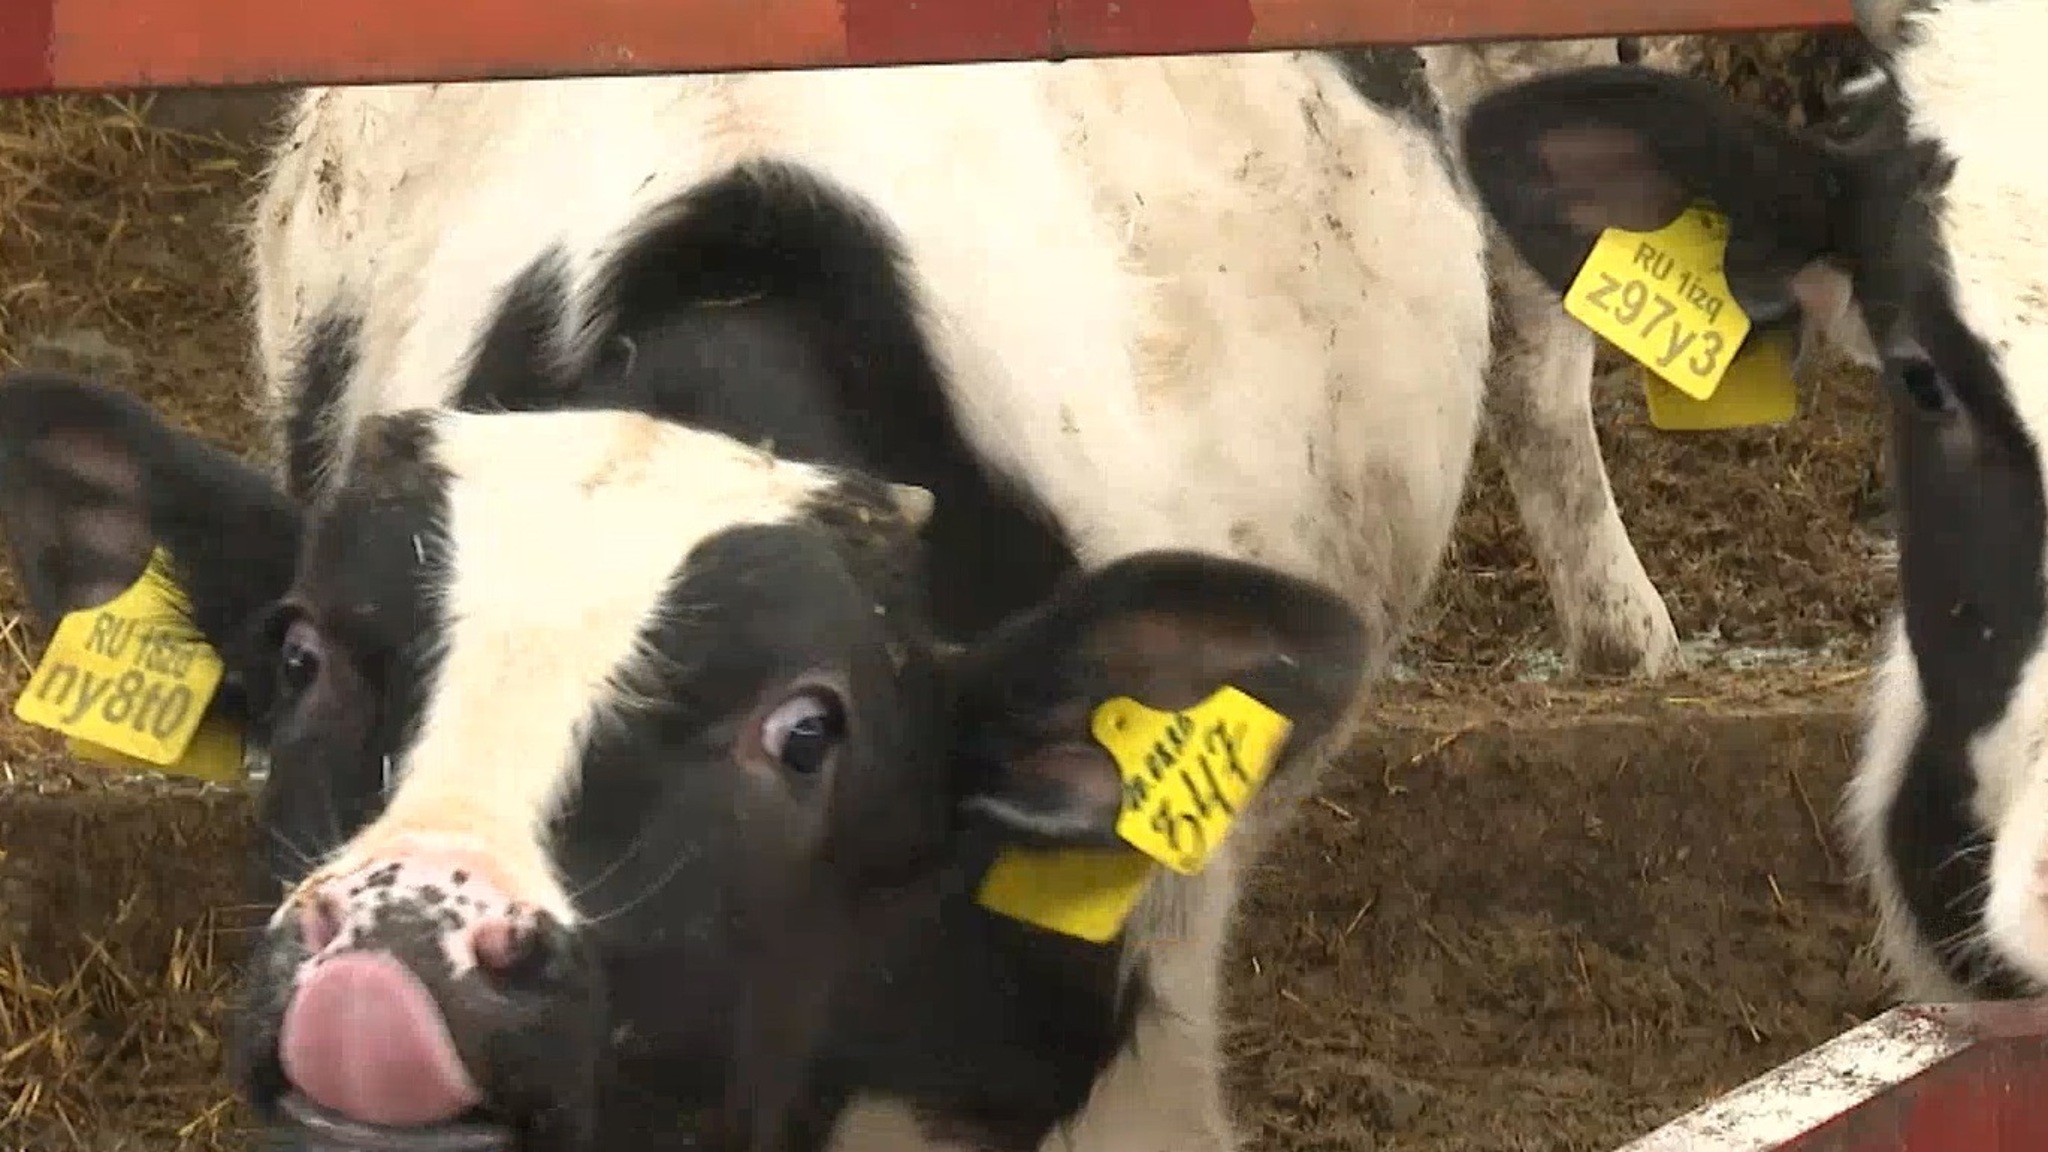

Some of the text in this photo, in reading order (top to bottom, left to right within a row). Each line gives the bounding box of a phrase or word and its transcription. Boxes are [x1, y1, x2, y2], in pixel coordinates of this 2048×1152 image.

[1633, 242, 1675, 281] RU
[1586, 271, 1723, 376] z97y3
[84, 611, 138, 659] RU
